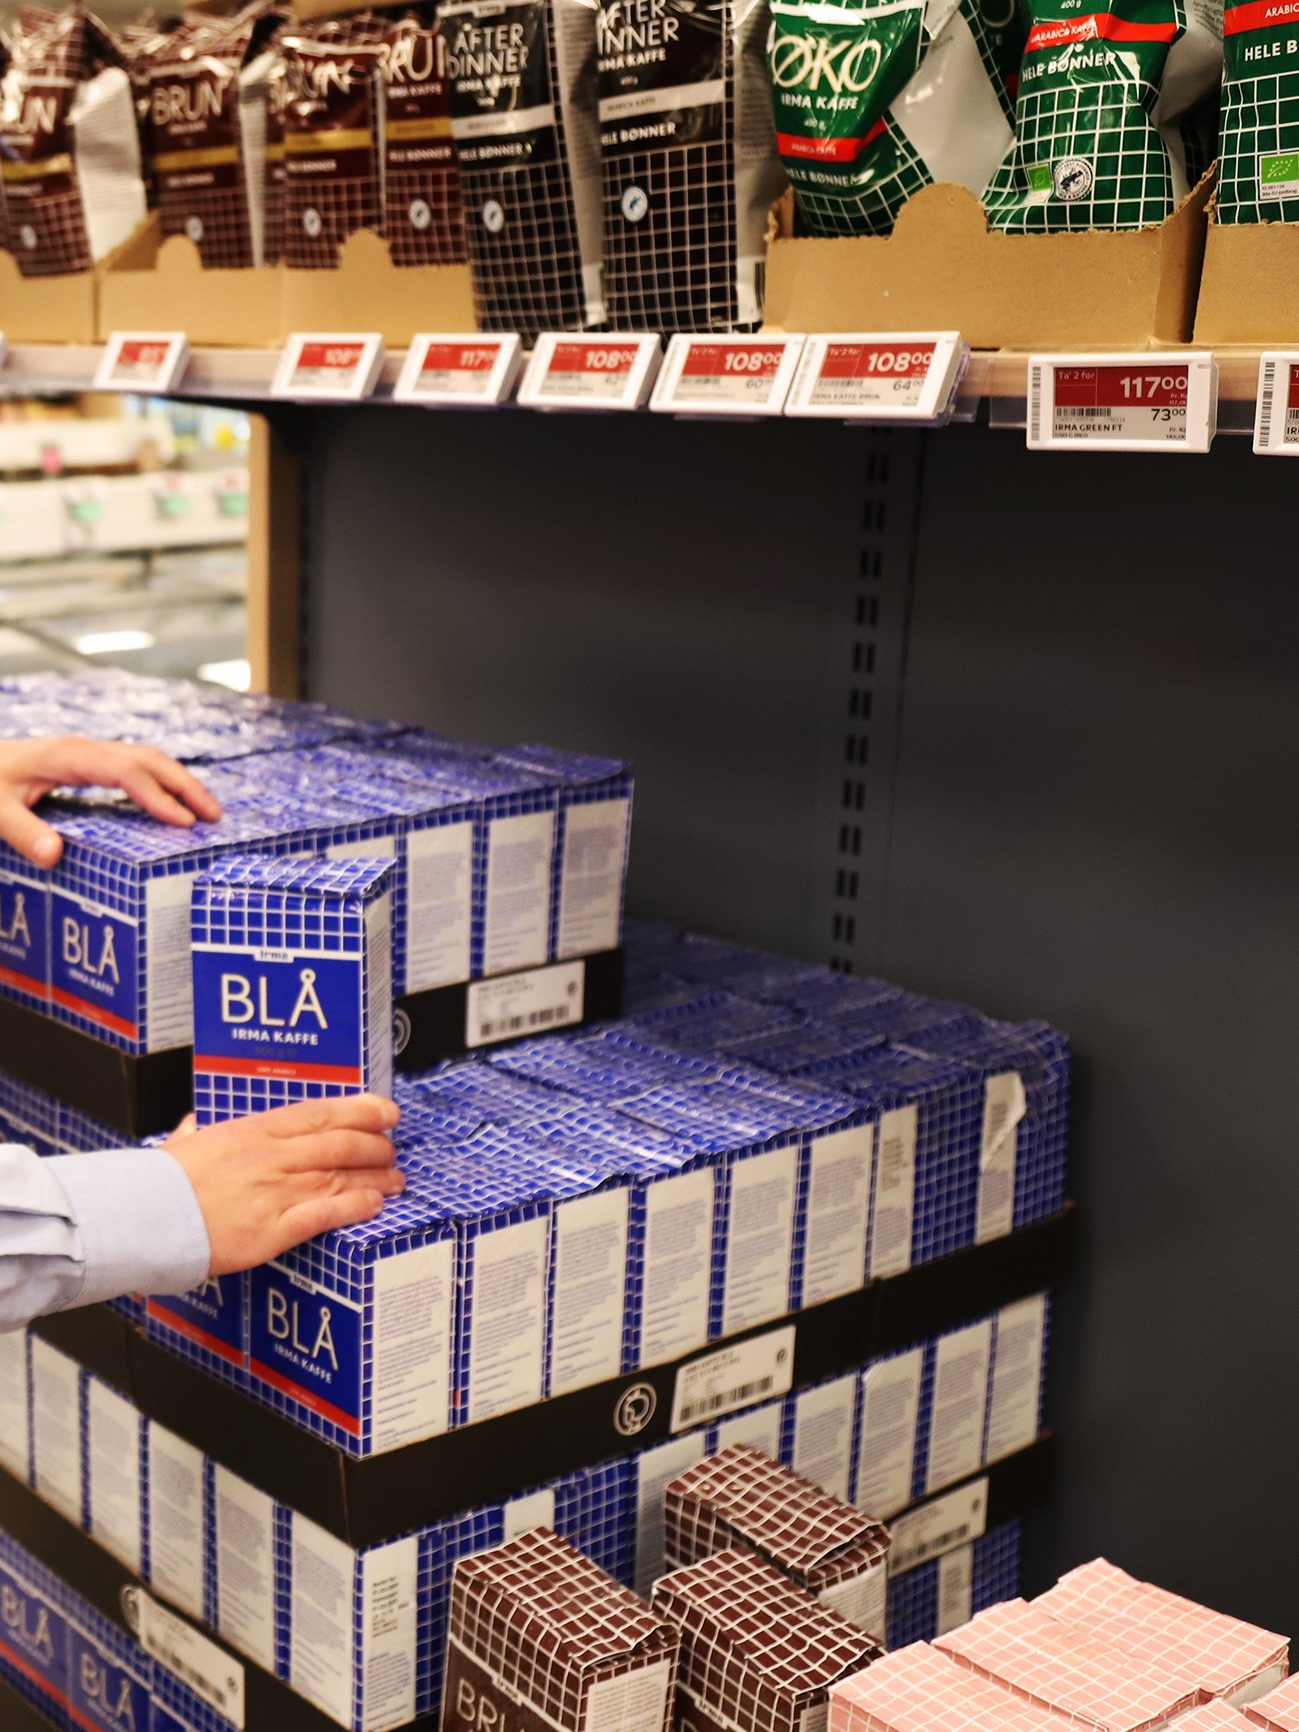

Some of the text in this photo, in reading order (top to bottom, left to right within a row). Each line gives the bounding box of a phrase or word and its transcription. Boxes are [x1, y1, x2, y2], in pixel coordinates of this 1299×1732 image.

[454, 23, 525, 55] AFTER
[1244, 42, 1282, 62] HELE
[626, 48, 667, 68] KAFFE
[771, 34, 882, 93] ØKO
[1047, 52, 1117, 75] BØNNER
[152, 80, 224, 126] BRUN
[780, 93, 859, 111] IRMA KAFFE
[1074, 371, 1080, 380] 2
[1081, 370, 1095, 380] for
[1054, 424, 1124, 432] IRMA GREEN FT
[63, 916, 120, 984] BLÅ
[220, 968, 329, 1030] BLÅ
[231, 1028, 319, 1046] IRMA KAFFE
[267, 1286, 339, 1371] BLÅ
[273, 1342, 333, 1384] IRMA KAFFE
